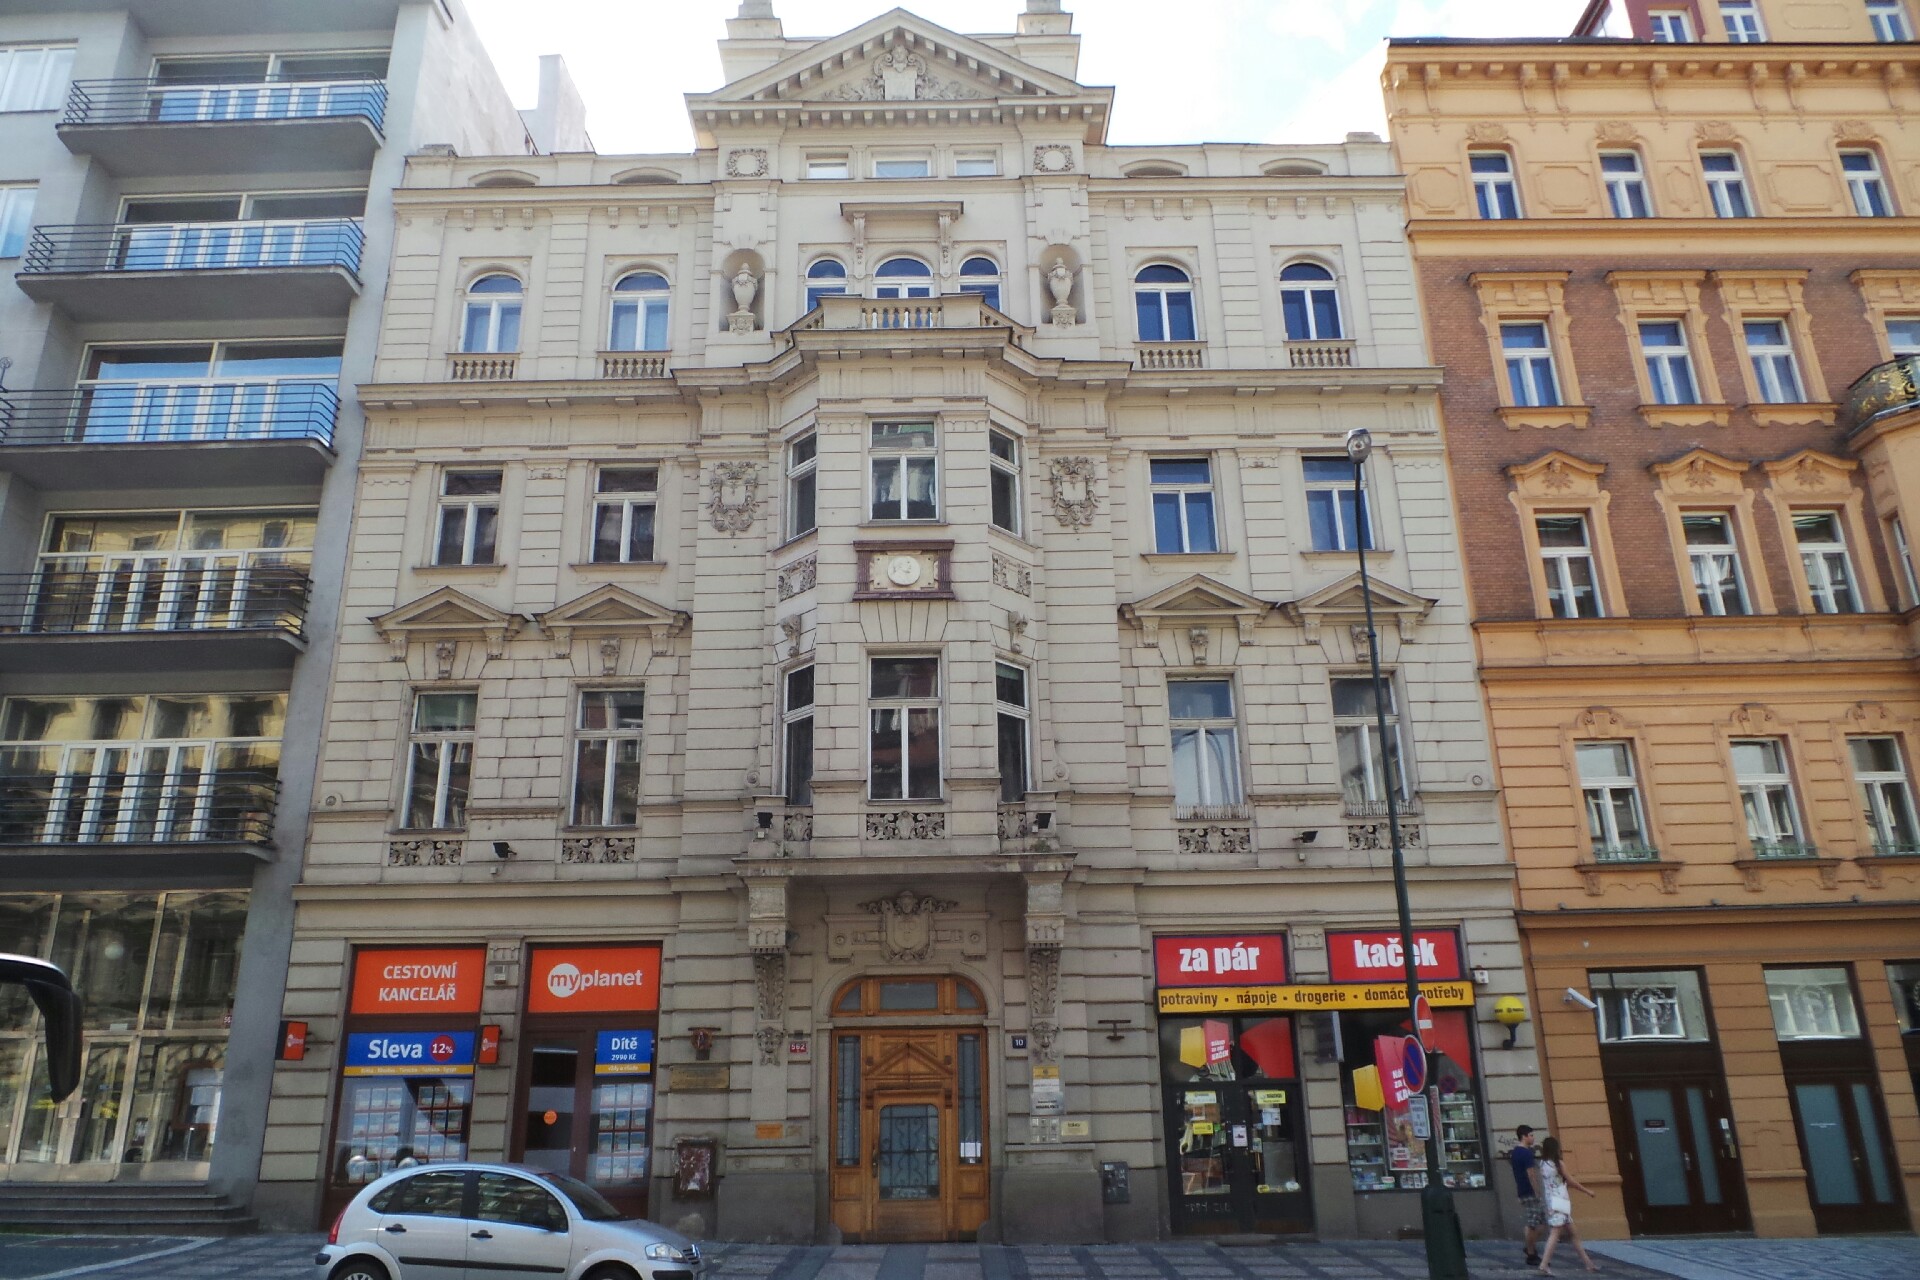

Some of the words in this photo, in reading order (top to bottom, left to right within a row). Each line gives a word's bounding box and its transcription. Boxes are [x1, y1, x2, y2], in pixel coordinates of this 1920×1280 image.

[1179, 947, 1209, 972] za
[1214, 941, 1260, 974] pár
[1353, 937, 1438, 968] kaček
[383, 962, 457, 979] CESTOVNÍ
[550, 969, 643, 991] myplanet
[378, 983, 456, 1002] KANCELÁŘ
[1160, 992, 1218, 1008] potraviny
[1236, 991, 1277, 1006] nápoje
[1294, 989, 1346, 1005] drogerie
[367, 1039, 423, 1059] Sleva
[432, 1043, 453, 1054] 12%
[611, 1036, 638, 1050] Dítě
[628, 1053, 637, 1061] Kč
